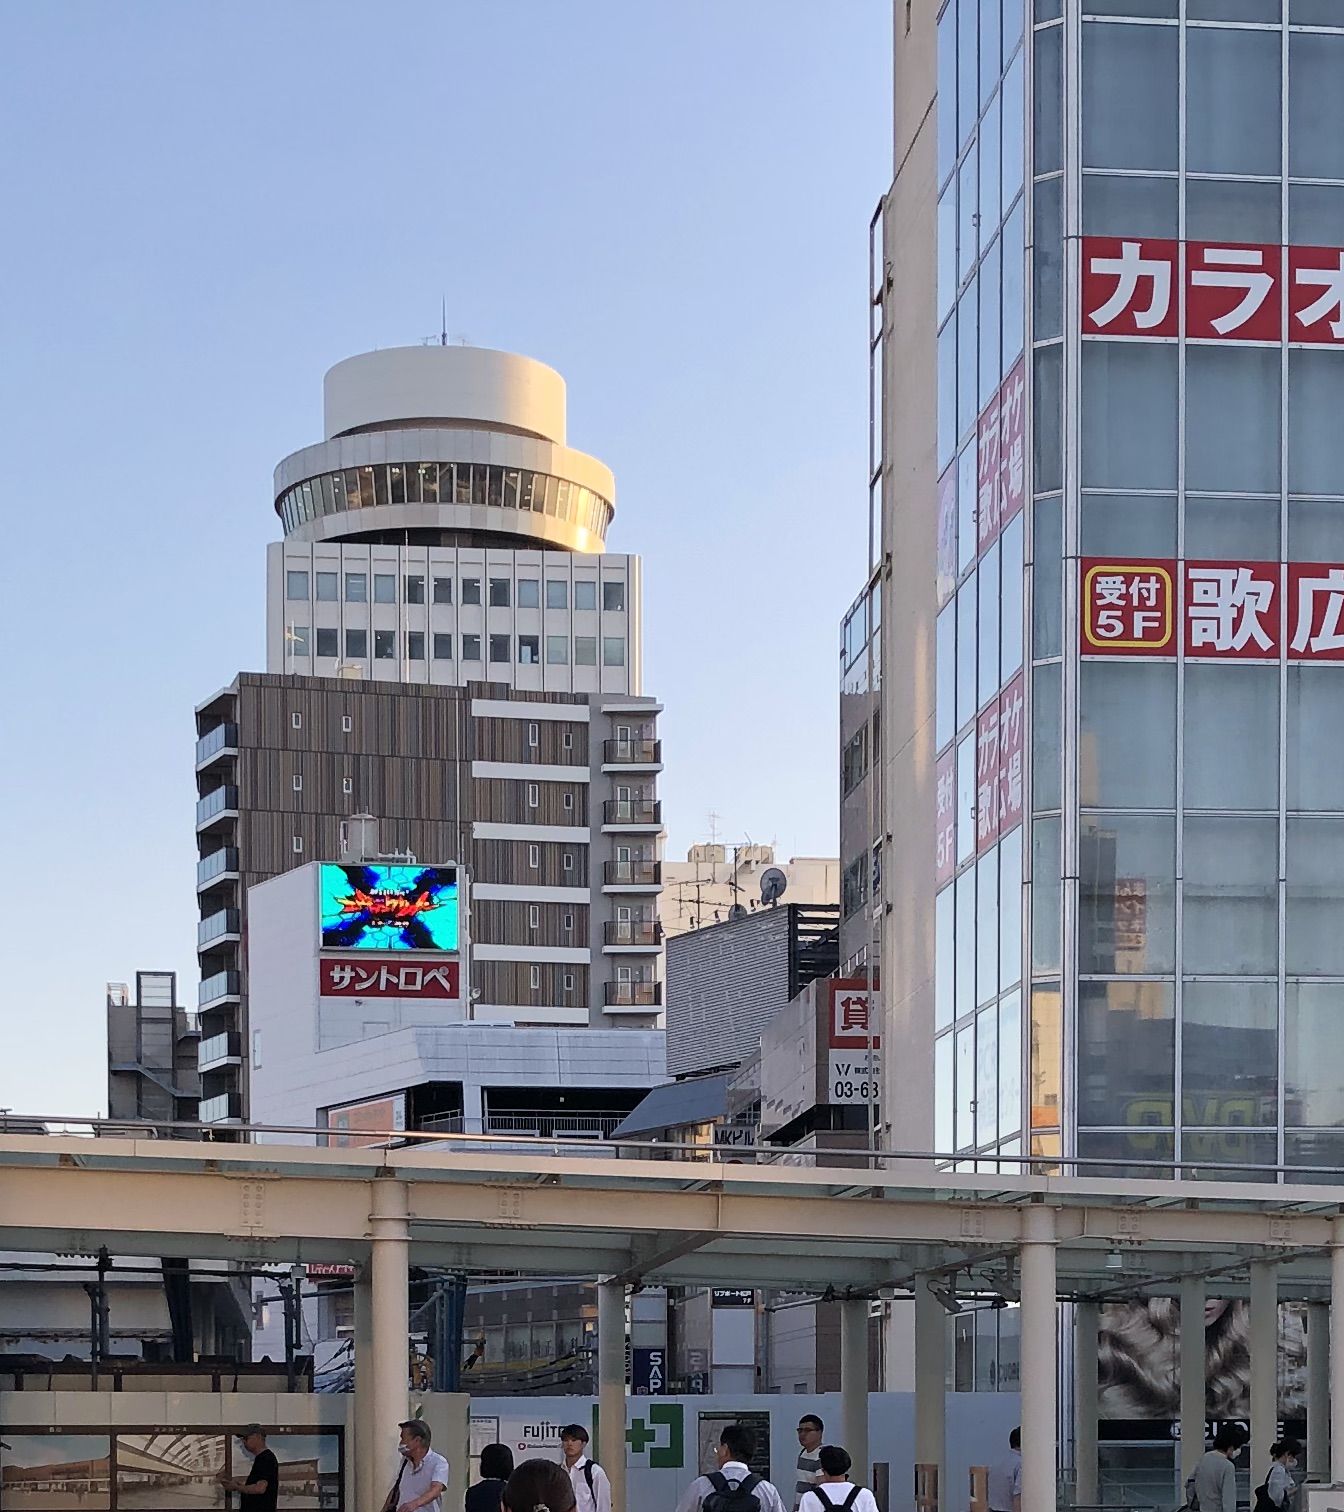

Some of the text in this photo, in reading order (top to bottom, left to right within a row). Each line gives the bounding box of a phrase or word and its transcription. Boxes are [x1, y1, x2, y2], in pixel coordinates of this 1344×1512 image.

[1095, 575, 1161, 607] 受付
[329, 964, 450, 993] サントロペ
